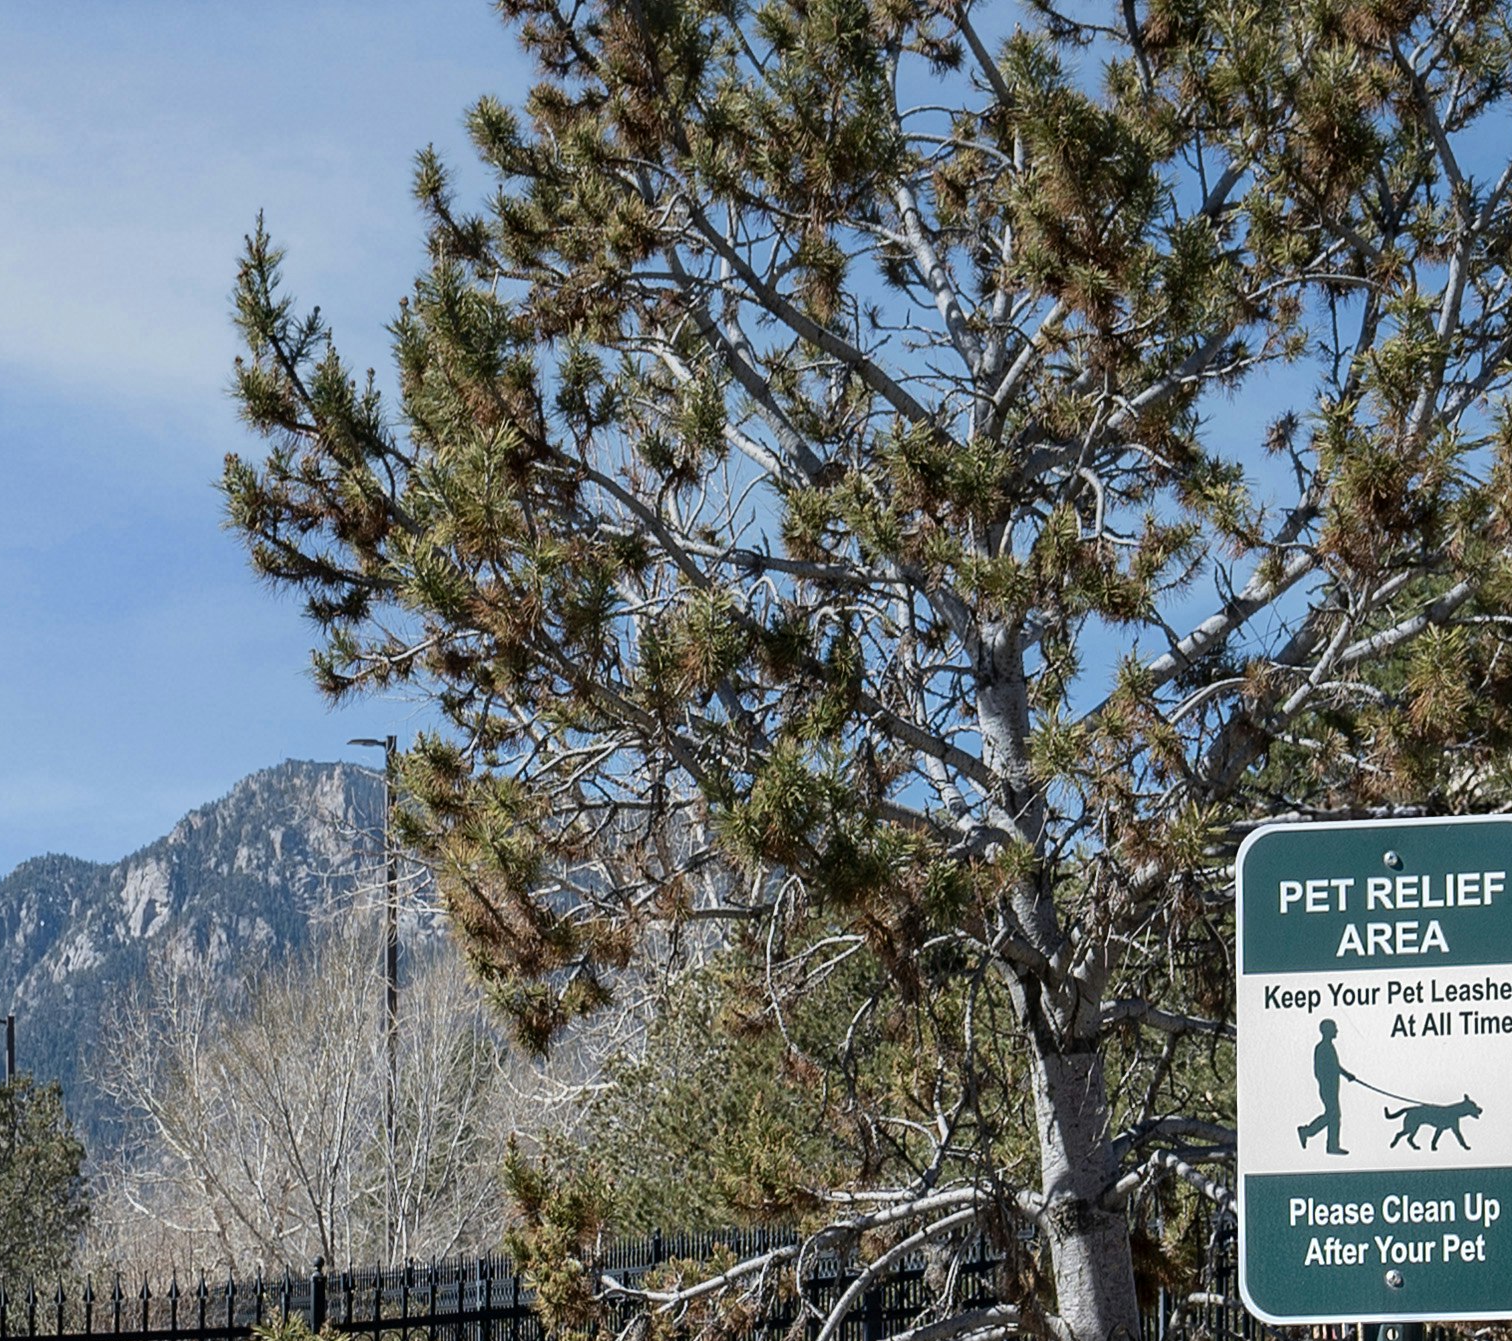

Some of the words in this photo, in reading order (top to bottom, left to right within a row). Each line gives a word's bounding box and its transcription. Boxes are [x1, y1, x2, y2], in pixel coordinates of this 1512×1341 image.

[1279, 878, 1355, 914] PET
[1366, 871, 1506, 911] RELIEF
[1335, 920, 1450, 957] AREA
[1264, 985, 1321, 1013] Keep
[1328, 983, 1381, 1006] Your
[1387, 980, 1424, 1004] Pet
[1390, 1013, 1416, 1038] At
[1421, 1012, 1452, 1037] All
[1289, 1197, 1375, 1226] Please
[1382, 1194, 1456, 1224] Clean
[1464, 1192, 1501, 1227] Up
[1304, 1236, 1369, 1266] After
[1374, 1235, 1436, 1264] Your
[1442, 1233, 1486, 1262] Pet
